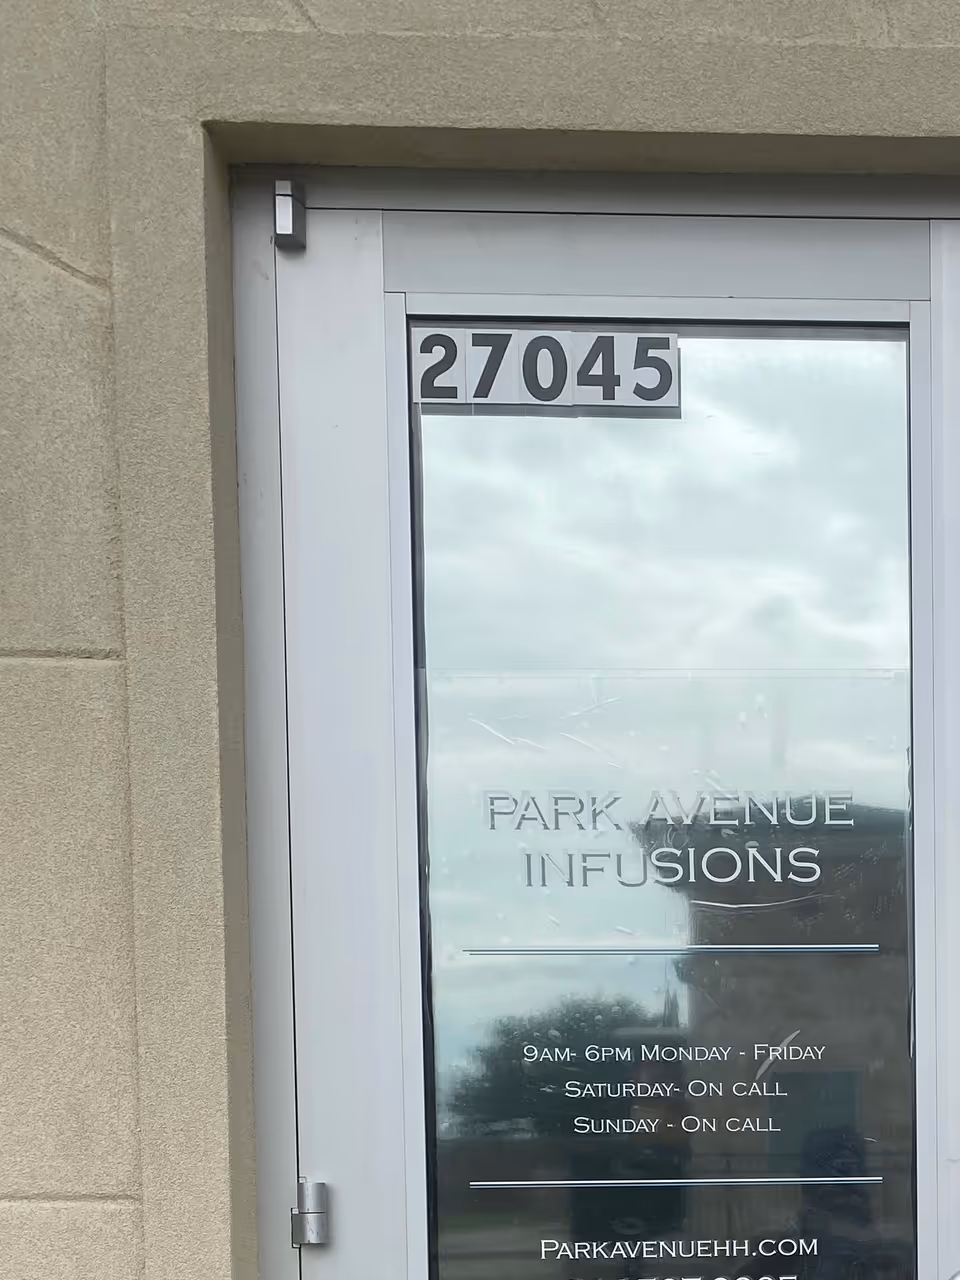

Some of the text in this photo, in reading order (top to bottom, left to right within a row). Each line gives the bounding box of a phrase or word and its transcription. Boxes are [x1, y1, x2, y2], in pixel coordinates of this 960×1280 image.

[419, 333, 673, 402] 27045
[484, 791, 854, 830] PARK AVENUE
[524, 847, 821, 887] INFUSIONS
